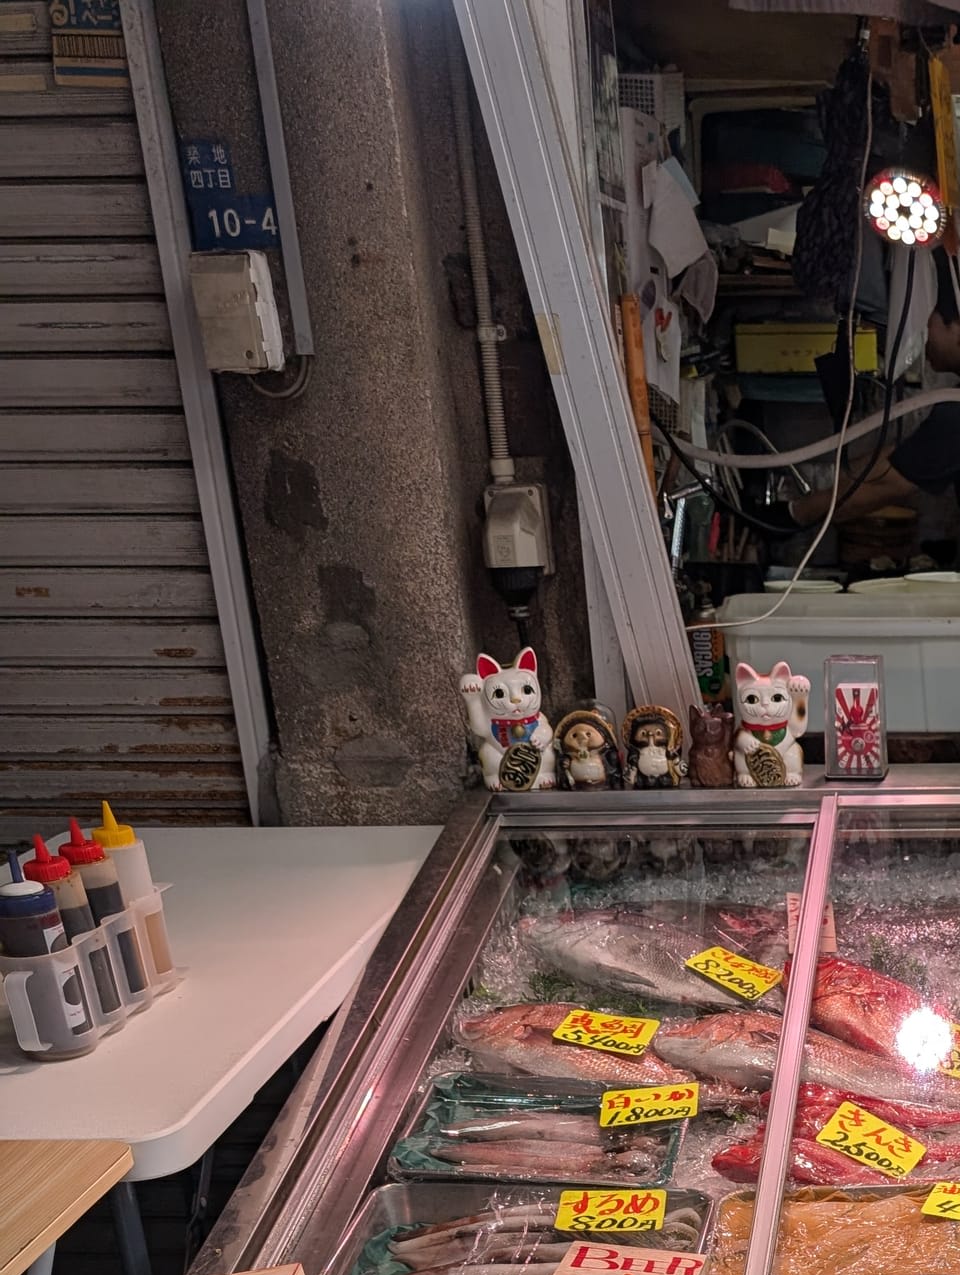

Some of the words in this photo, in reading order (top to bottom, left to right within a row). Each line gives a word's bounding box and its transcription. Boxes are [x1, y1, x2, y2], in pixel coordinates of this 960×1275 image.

[190, 169, 231, 189] 四丁目
[208, 207, 278, 238] 10-4
[838, 1107, 913, 1159] きんき
[562, 1191, 661, 1217] するめ
[567, 1215, 657, 1231] 800円
